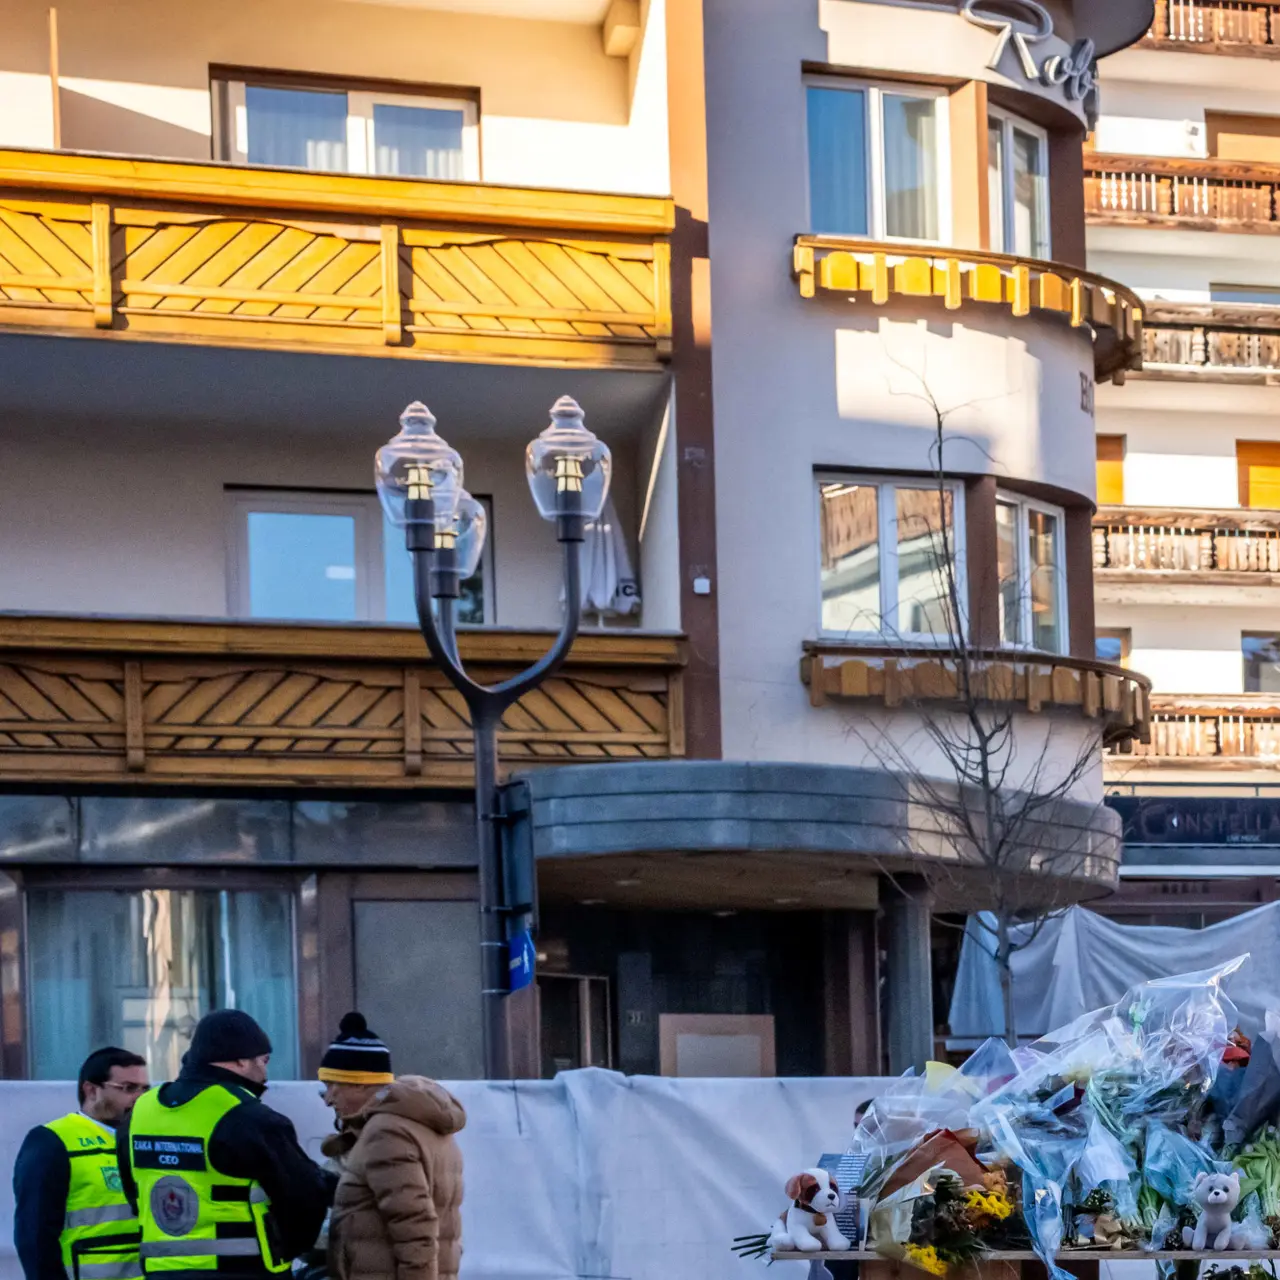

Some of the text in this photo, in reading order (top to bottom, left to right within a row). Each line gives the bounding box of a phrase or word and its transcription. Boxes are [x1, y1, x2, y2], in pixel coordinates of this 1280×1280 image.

[78, 1136, 107, 1148] ZAA
[133, 1140, 203, 1153] ZAKA INTERNATIONAL
[158, 1154, 180, 1165] CEO
